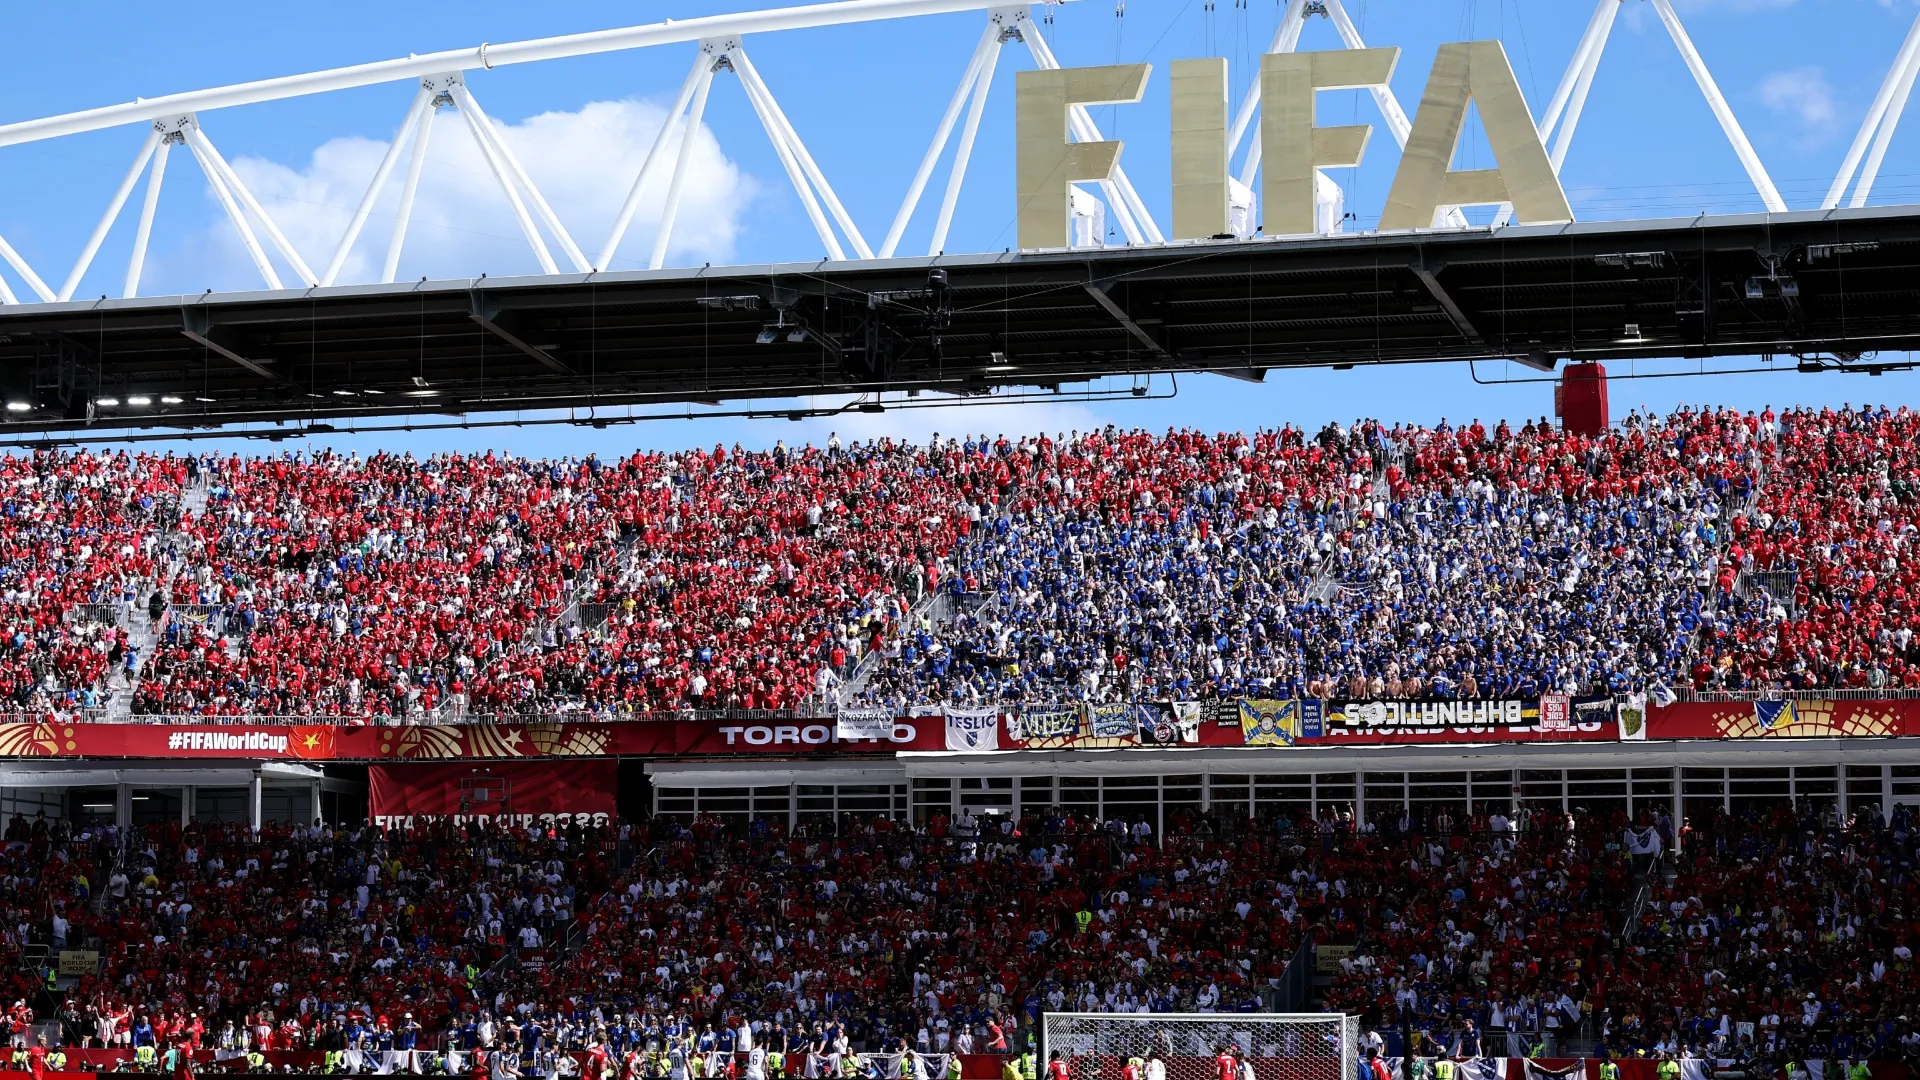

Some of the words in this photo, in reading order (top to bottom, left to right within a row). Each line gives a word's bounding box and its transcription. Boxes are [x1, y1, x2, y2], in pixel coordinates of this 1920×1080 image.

[1016, 39, 1574, 250] FIFA
[947, 710, 996, 729] TESLIĆ
[168, 732, 287, 753] #FIFAWorldCup
[719, 724, 916, 745] TOROO
[375, 815, 414, 831] FIFA
[671, 1056, 680, 1069] 10
[752, 1054, 758, 1066] 6
